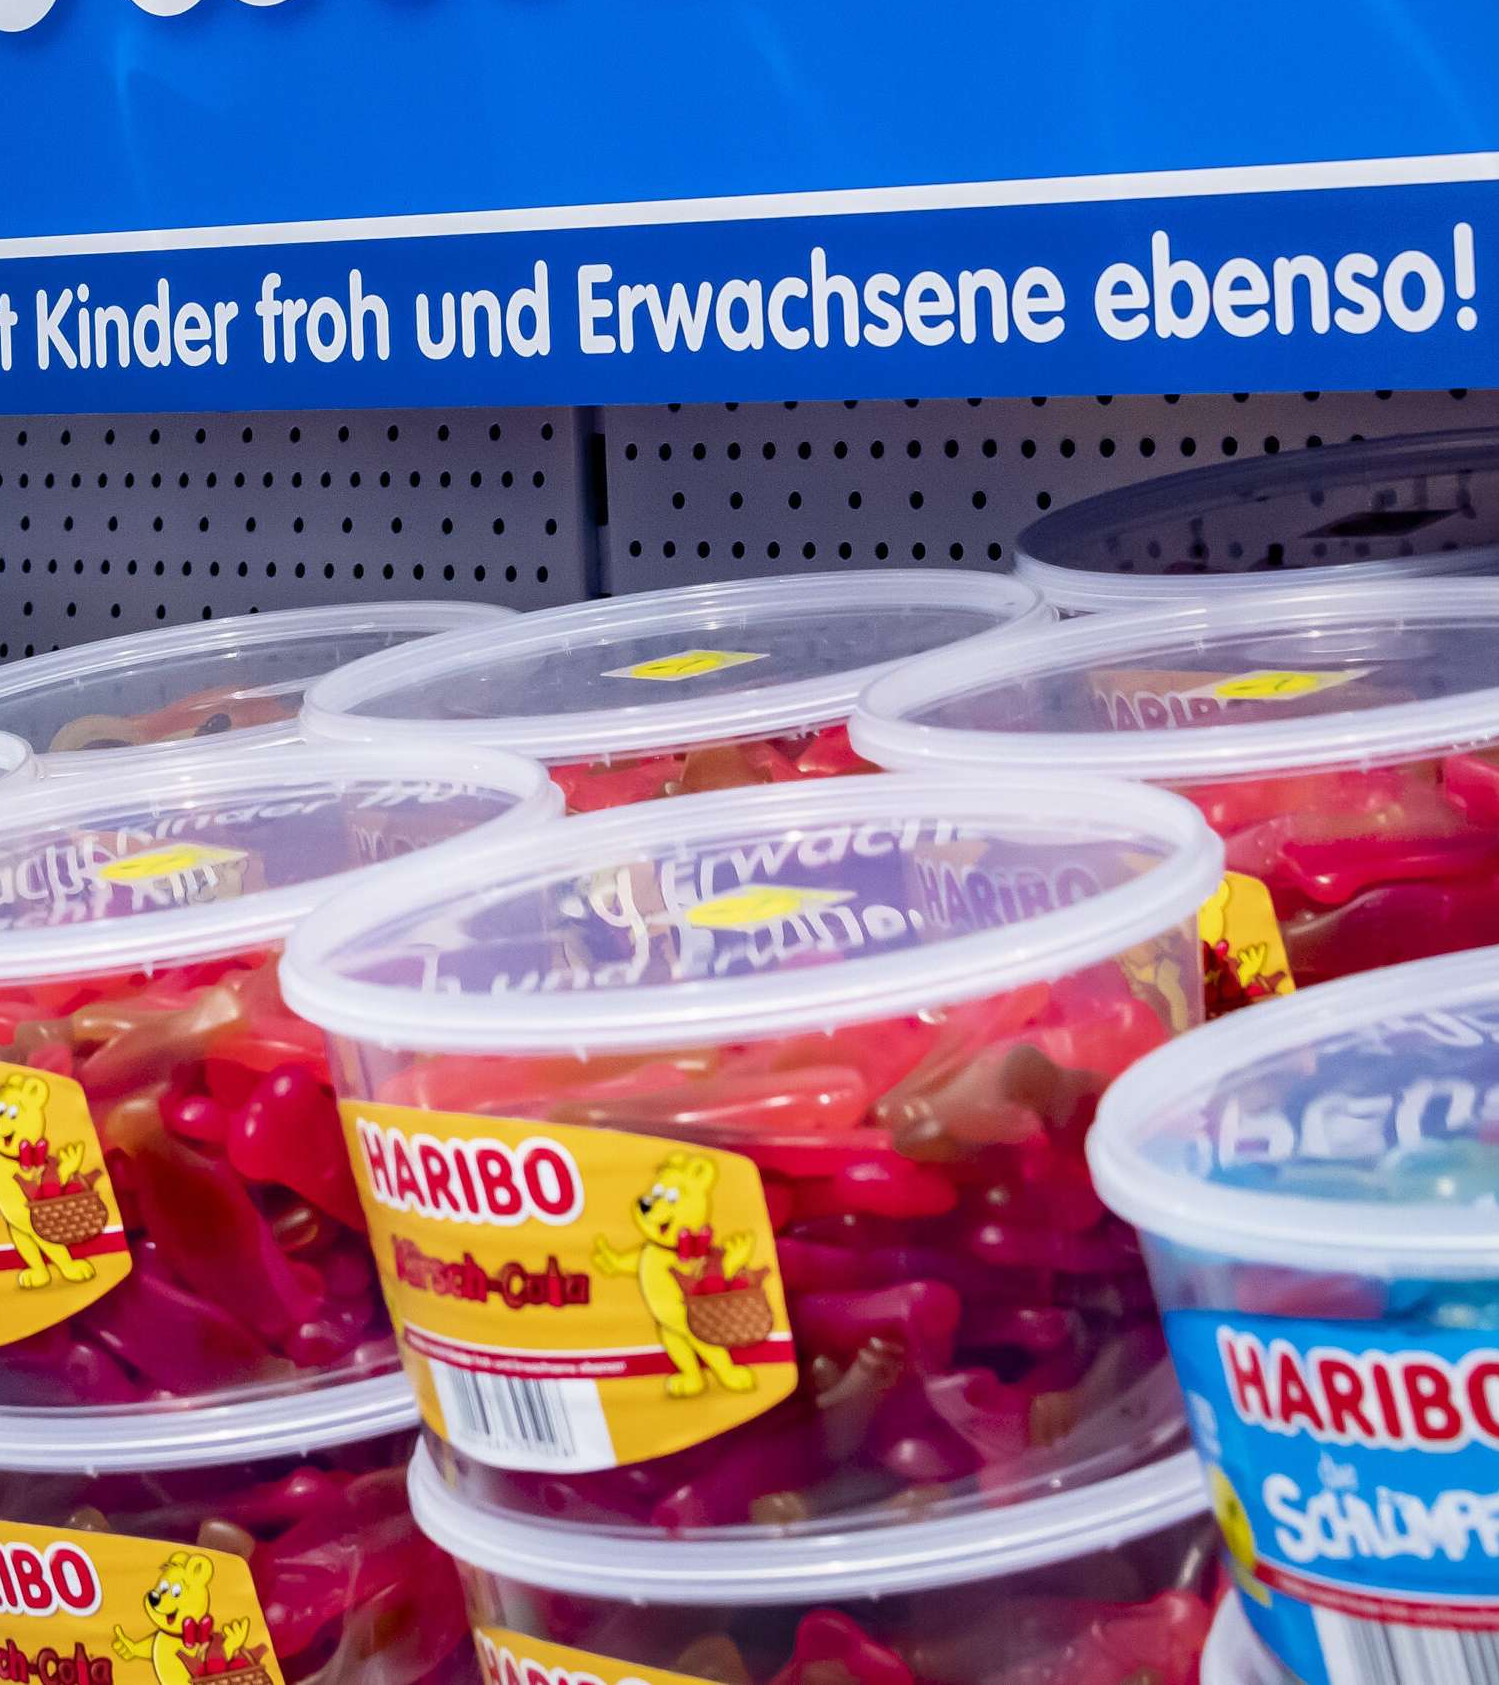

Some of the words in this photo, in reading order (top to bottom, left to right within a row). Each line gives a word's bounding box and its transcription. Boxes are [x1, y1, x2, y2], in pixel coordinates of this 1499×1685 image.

[36, 277, 239, 371] Kinder
[254, 267, 391, 364] froh
[415, 259, 551, 359] und
[577, 246, 1067, 354] Erwachsene
[1094, 221, 1479, 341] ebenso!
[362, 1124, 575, 1216] HARIBO
